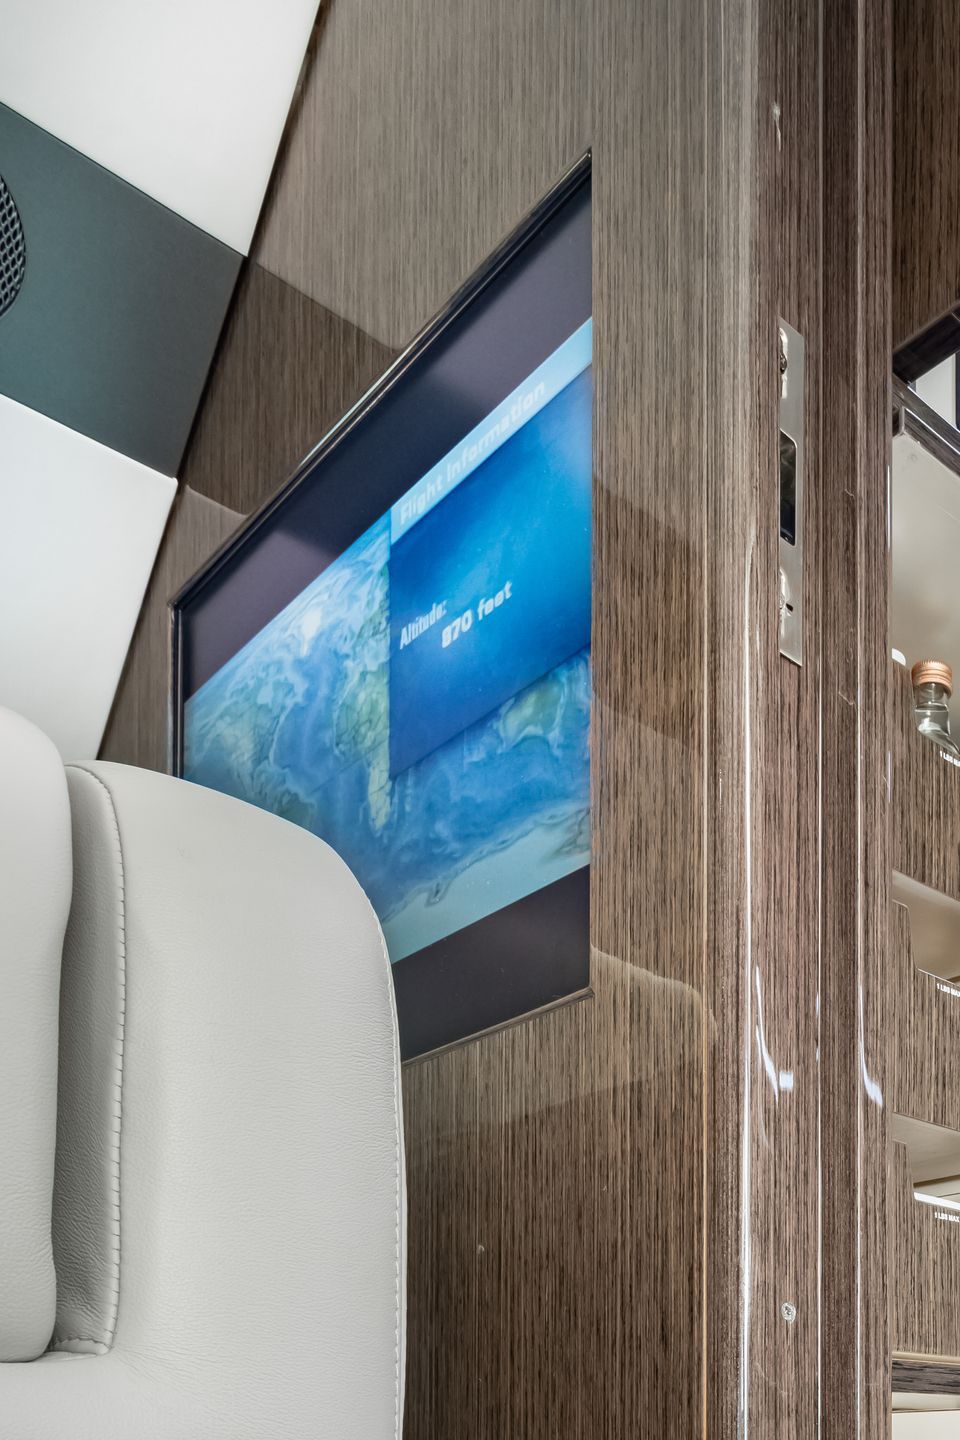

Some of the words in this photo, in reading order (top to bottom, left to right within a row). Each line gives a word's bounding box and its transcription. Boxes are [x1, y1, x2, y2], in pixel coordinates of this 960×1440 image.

[400, 474, 444, 525] Flight
[447, 382, 545, 482] Information
[400, 600, 447, 650] Altitude:
[477, 580, 513, 621] feet
